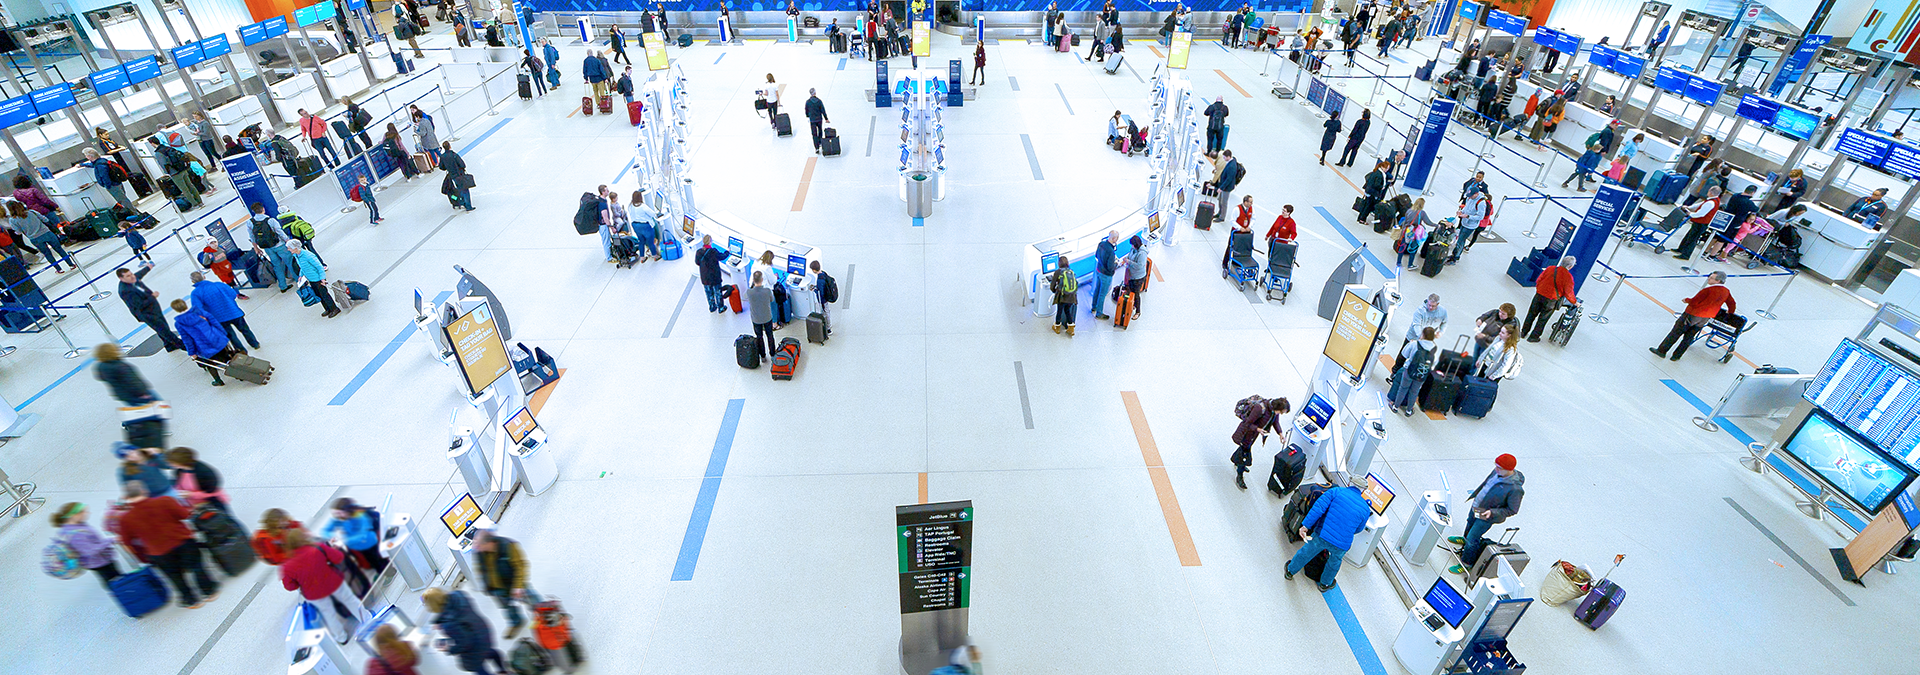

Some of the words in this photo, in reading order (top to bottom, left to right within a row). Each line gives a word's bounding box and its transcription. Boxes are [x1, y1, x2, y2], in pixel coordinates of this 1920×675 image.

[1847, 131, 1865, 140] SPECIAL
[1866, 138, 1888, 148] SERVICES
[1893, 147, 1914, 156] SPECIAL
[234, 170, 260, 181] ASSISTANCE
[1593, 203, 1615, 212] SERVICES
[1595, 198, 1614, 207] SPECIAL
[478, 310, 484, 318] 1
[1343, 310, 1364, 325] CHECK-IN
[1372, 313, 1377, 321] 1
[1341, 315, 1351, 323] TAG
[1350, 320, 1362, 331] YOUR
[1361, 328, 1372, 337] BAG
[458, 328, 481, 346] CHECK-IN
[460, 343, 471, 351] TAG
[471, 336, 484, 346] YOUR
[483, 327, 493, 337] BAG
[1897, 496, 1909, 513] Directory
